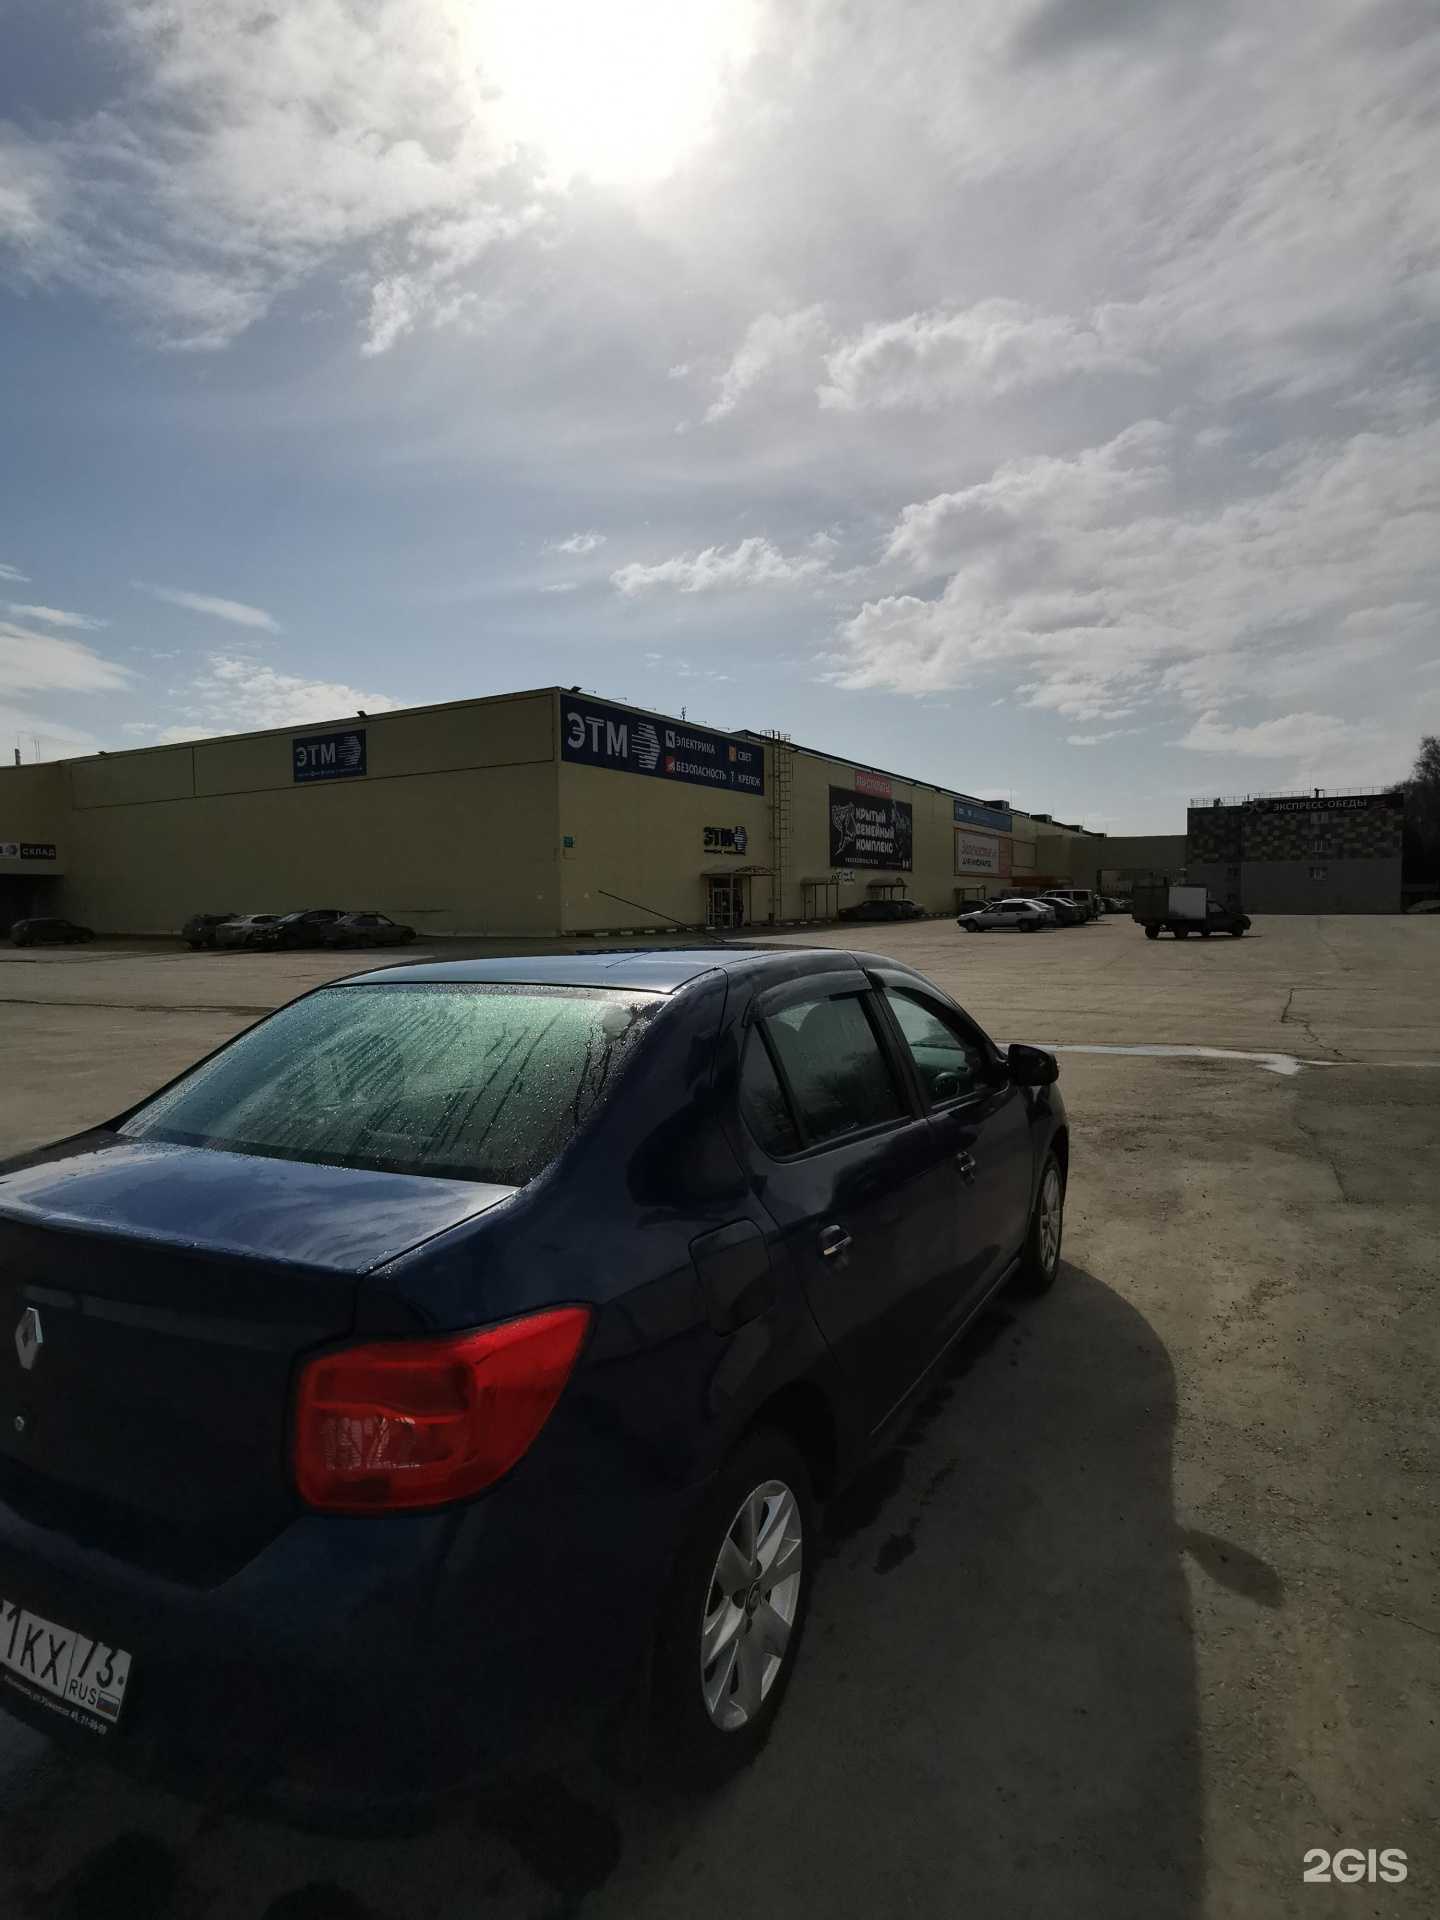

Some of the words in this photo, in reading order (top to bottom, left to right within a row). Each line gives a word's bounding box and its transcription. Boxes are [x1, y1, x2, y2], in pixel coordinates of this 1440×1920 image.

[567, 712, 629, 758] ЭТМ
[675, 735, 716, 754] ЭЛЕКТРИКА
[296, 742, 337, 768] ЭТМ
[676, 761, 727, 781] БЕЗОПАСНОСТЬ
[1273, 799, 1369, 811] ЭКСПРЕСС-ОБЕДЫ
[855, 808, 886, 824] КРЫТЫЙ
[855, 823, 895, 840] СЕМЕЙНЫЙ
[22, 847, 56, 857] СКЛАД
[855, 839, 894, 855] КОМПЛЕКС
[69, 1679, 97, 1705] RUS
